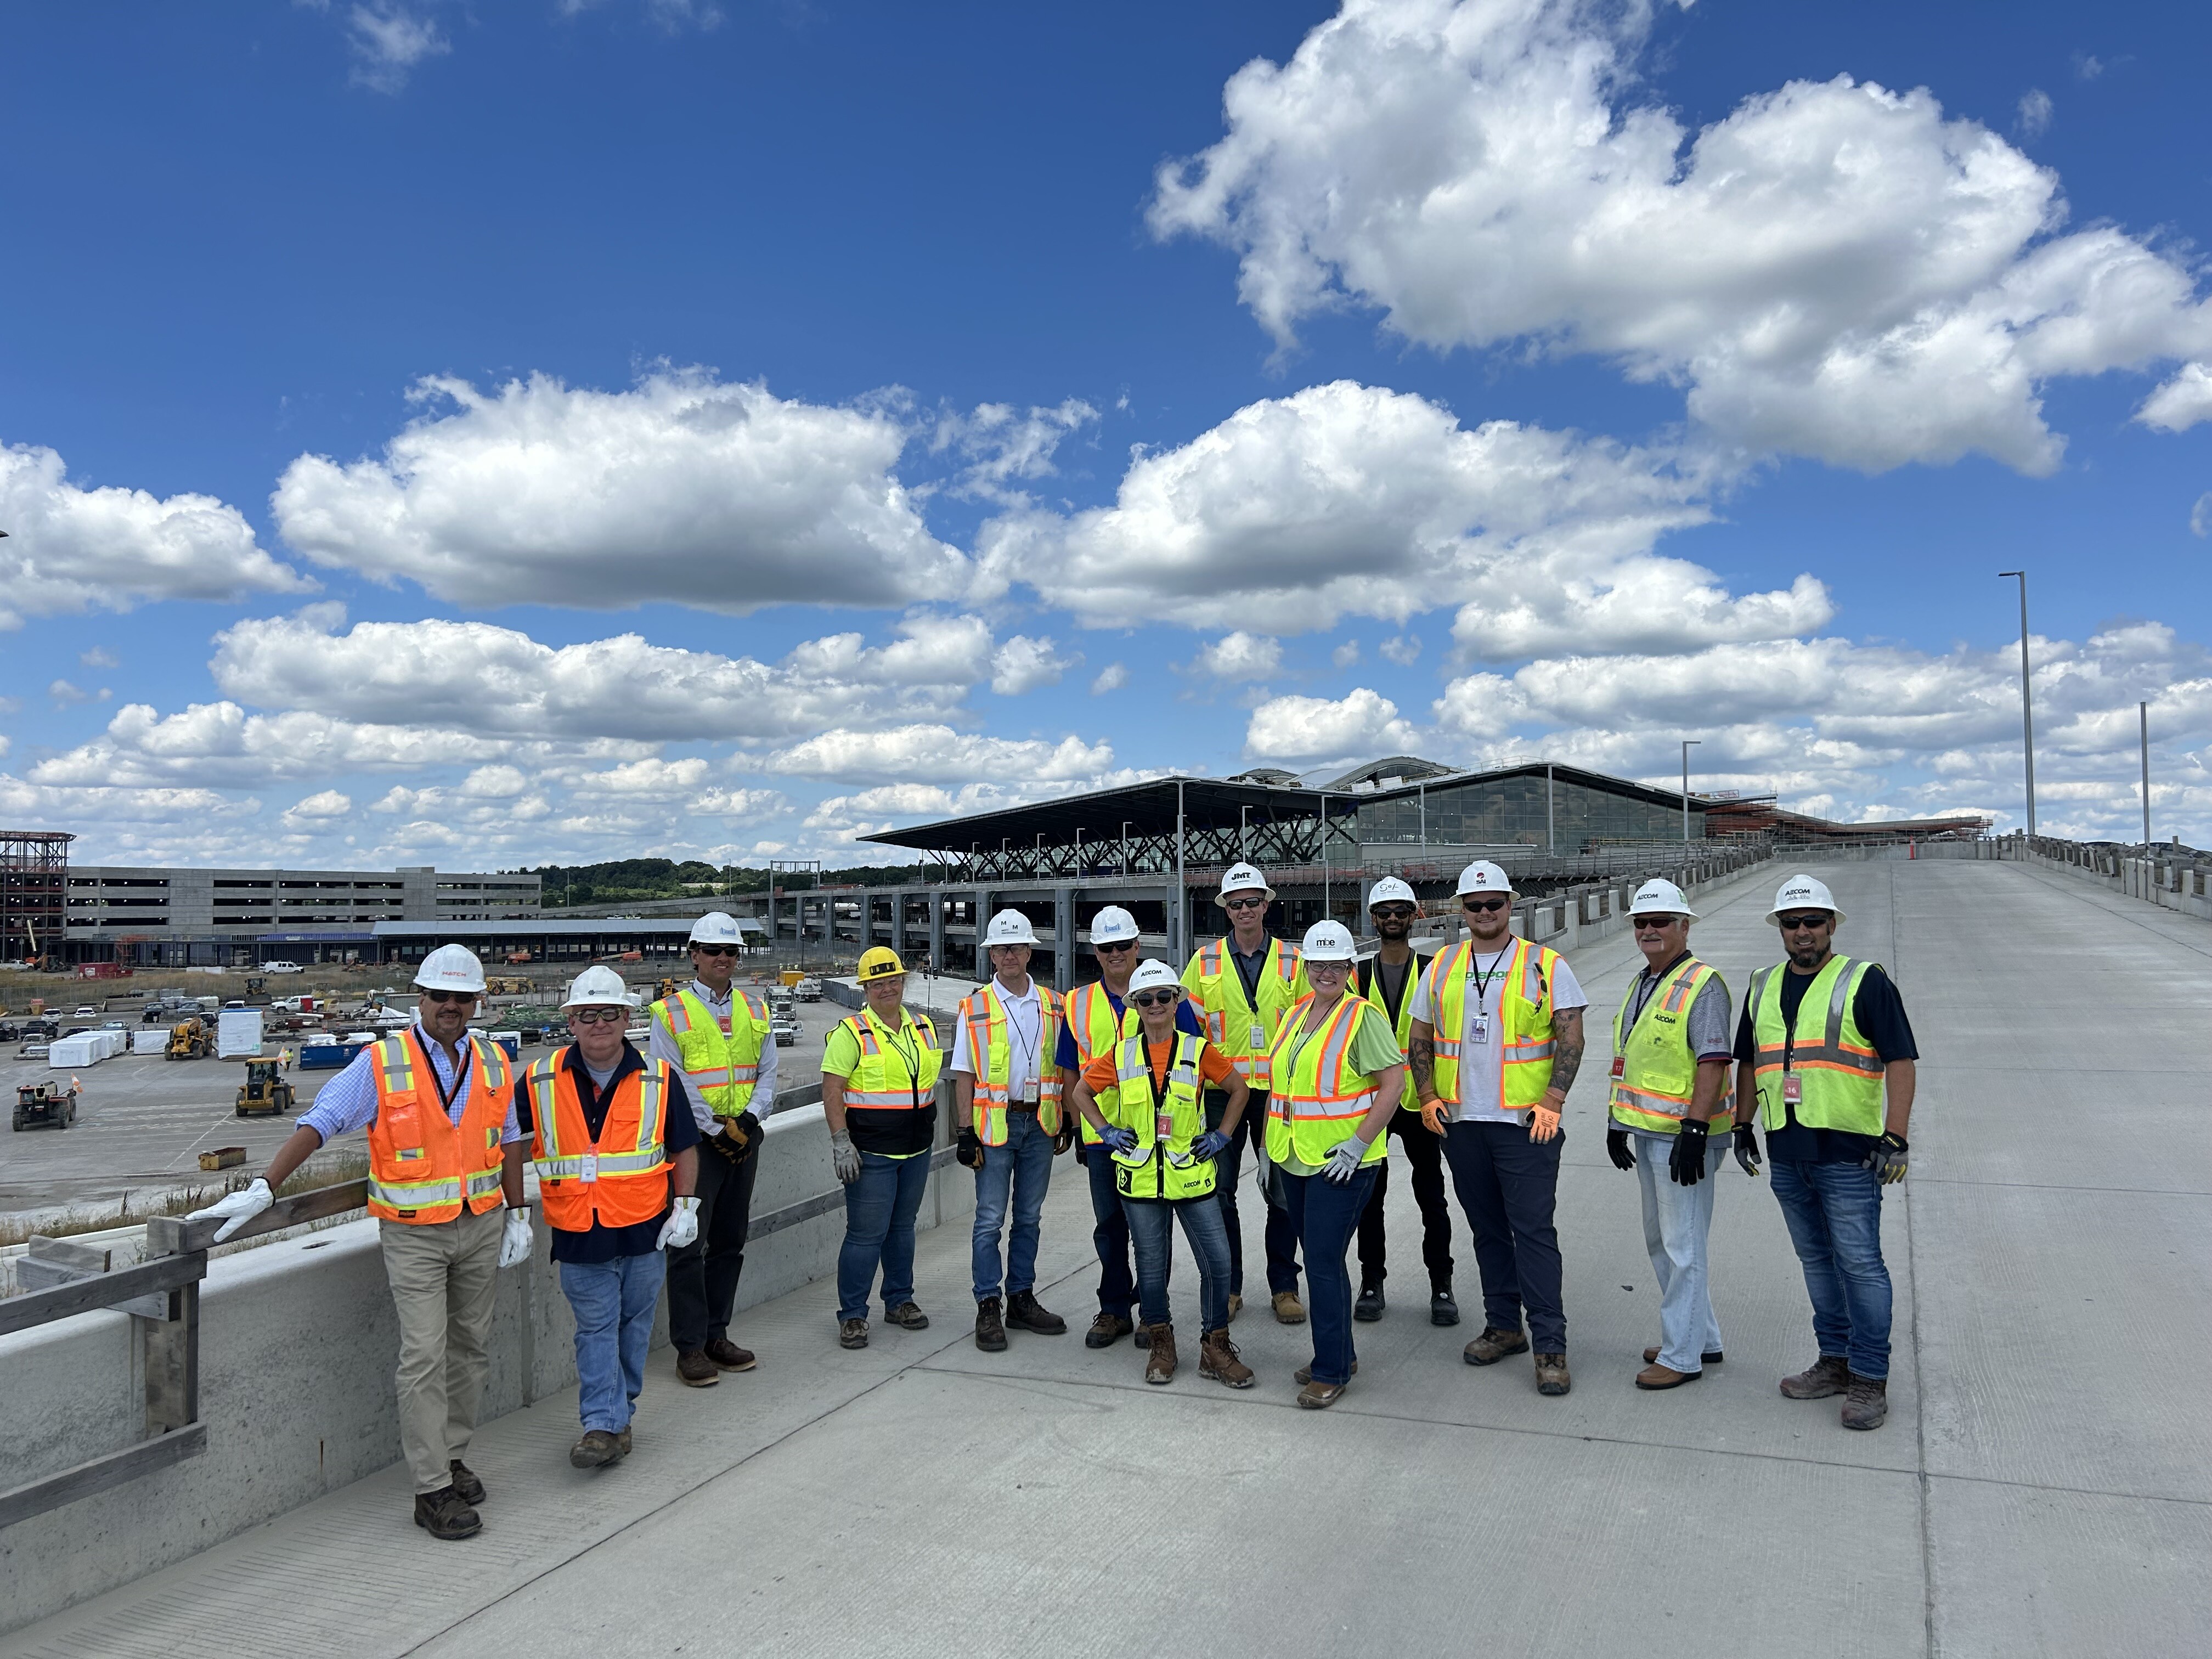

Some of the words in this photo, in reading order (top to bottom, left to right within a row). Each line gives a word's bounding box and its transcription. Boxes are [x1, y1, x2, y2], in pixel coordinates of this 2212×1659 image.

[1316, 938, 1335, 946] mbe
[1654, 1014, 1676, 1024] AECOM
[1183, 1179, 1201, 1189] AECOM
